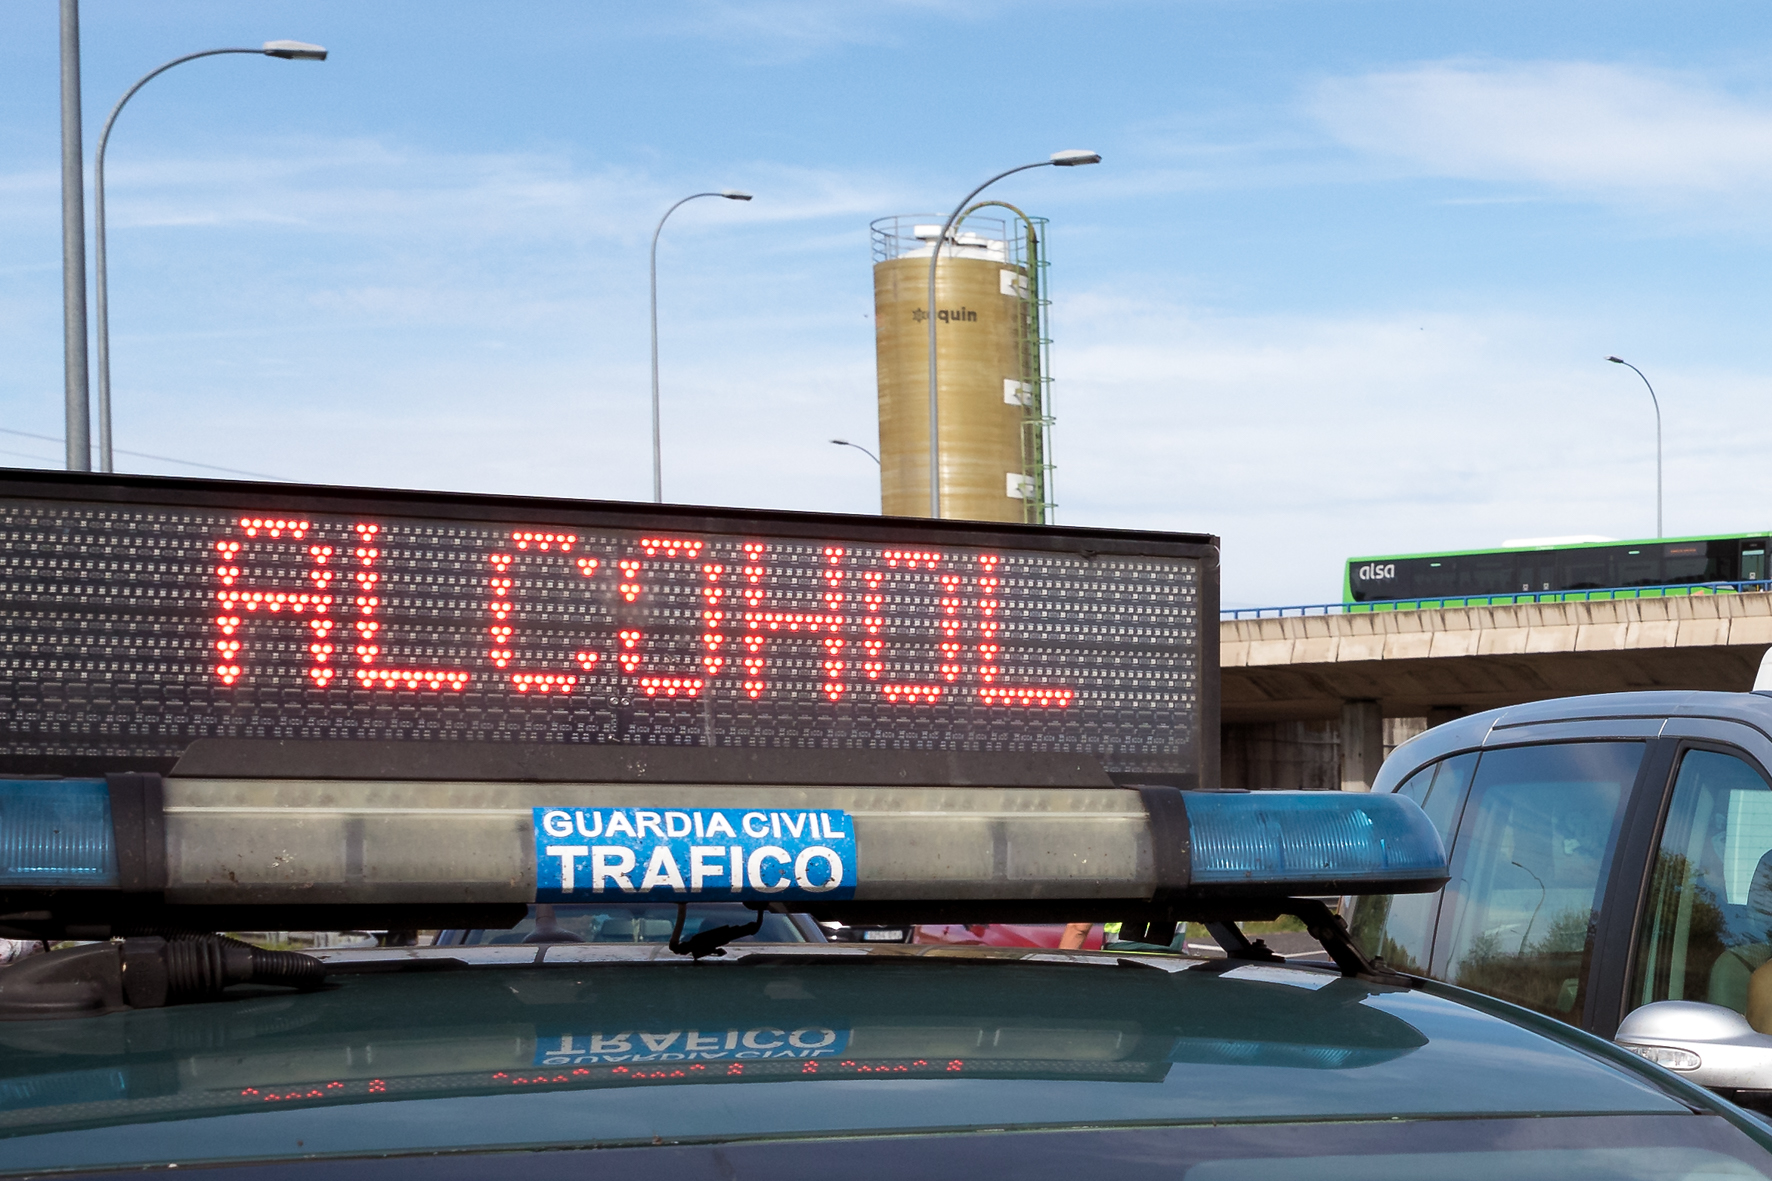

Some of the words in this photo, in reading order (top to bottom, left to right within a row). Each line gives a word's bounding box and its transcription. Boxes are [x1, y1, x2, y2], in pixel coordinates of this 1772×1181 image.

[927, 306, 978, 324] quin
[1359, 562, 1395, 580] alsa
[215, 516, 1075, 708] ALCOHOL
[542, 810, 737, 839] GUARDIA
[742, 811, 846, 839] CIVIL
[546, 845, 844, 894] TRAFICO
